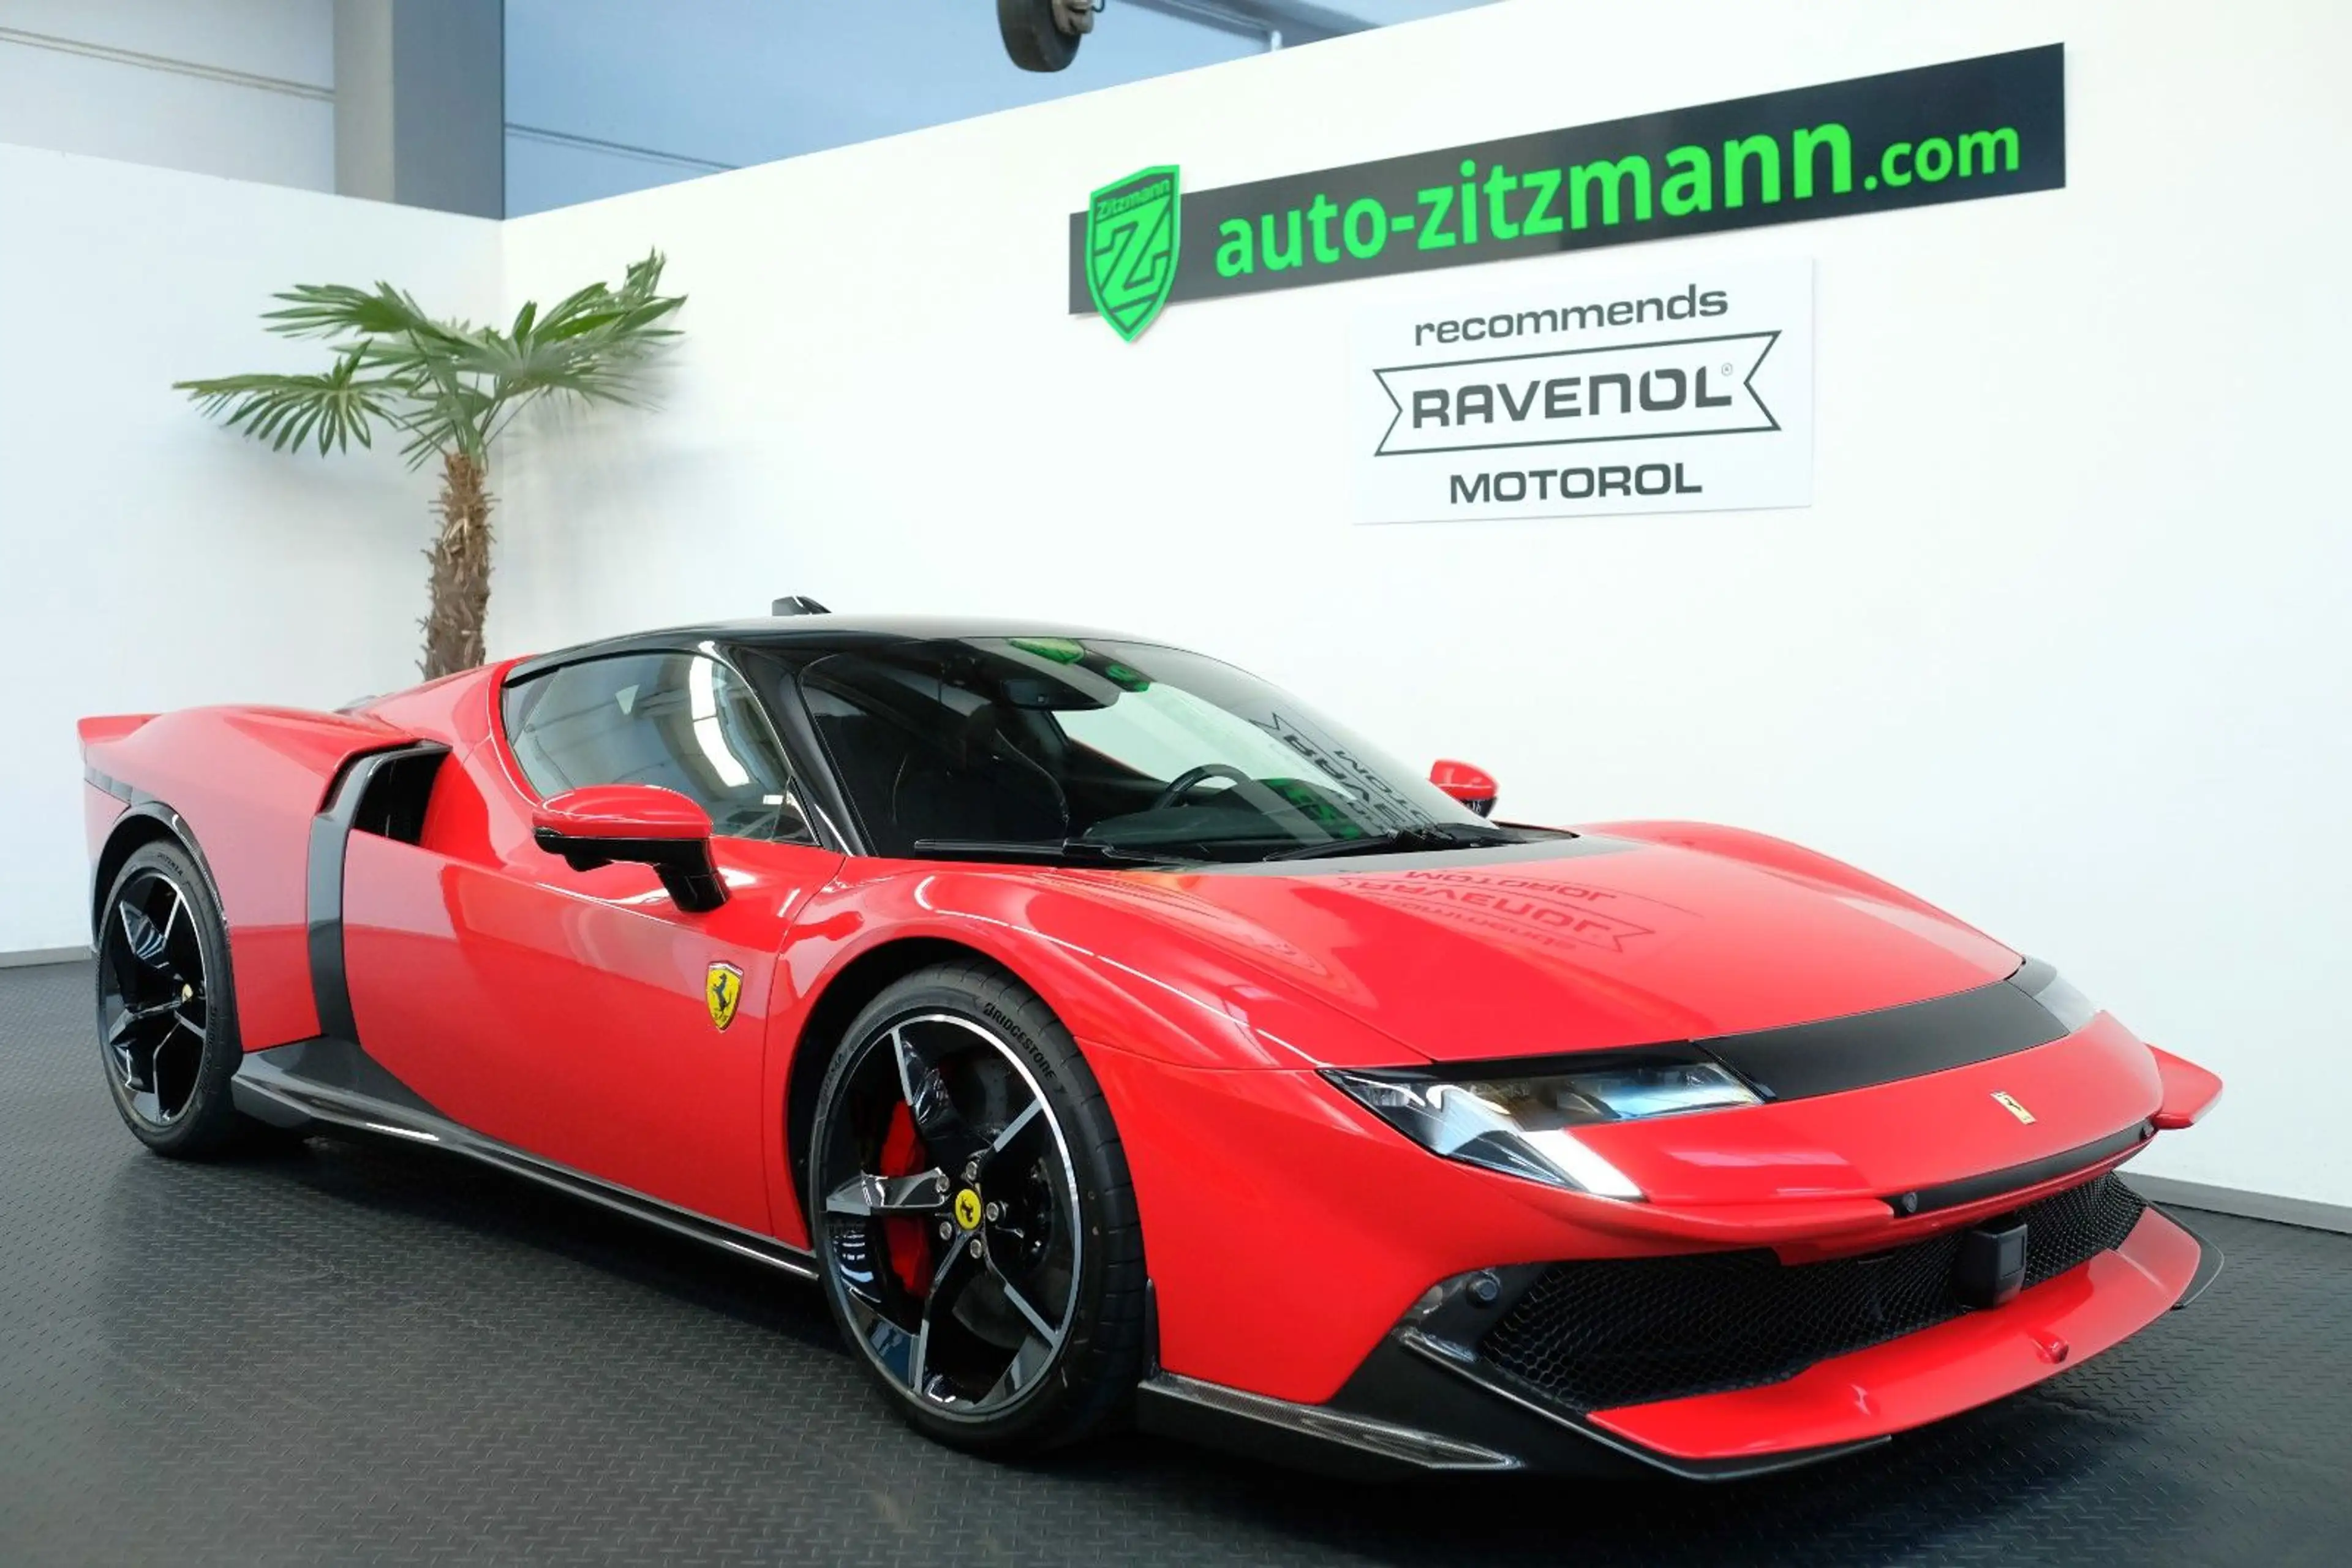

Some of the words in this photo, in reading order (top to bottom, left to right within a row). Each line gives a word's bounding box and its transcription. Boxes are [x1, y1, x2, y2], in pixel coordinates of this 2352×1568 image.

[1216, 122, 2019, 277] auto-zitzmann.com
[1415, 284, 1728, 346] recommends
[1450, 462, 1702, 503] MOTOROL
[983, 1002, 1058, 1080] BRIDGESTONE
